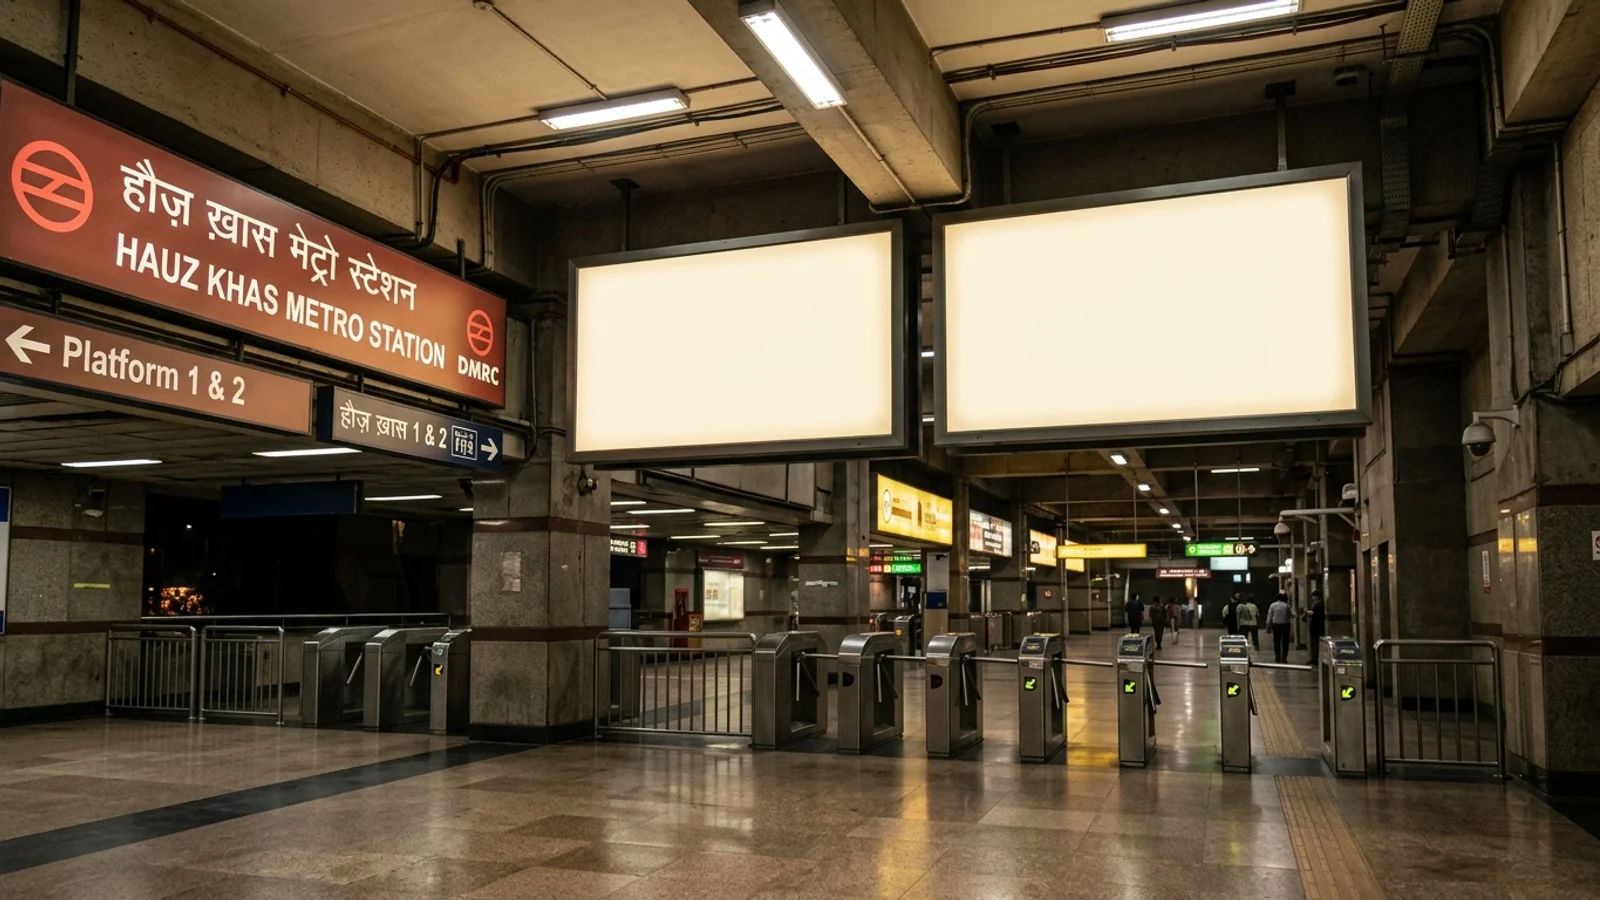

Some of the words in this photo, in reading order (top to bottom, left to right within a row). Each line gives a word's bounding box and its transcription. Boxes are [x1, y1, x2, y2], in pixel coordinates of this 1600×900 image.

[120, 159, 194, 227] हौज़
[206, 199, 278, 258] ख़ास
[289, 223, 339, 287] मेट्रो
[348, 253, 417, 311] स्टेशन
[116, 232, 200, 291] HAUZ
[207, 264, 278, 315] KHAS
[286, 291, 364, 342] METRO
[369, 320, 445, 369] STATION
[62, 335, 179, 391] Platform
[188, 365, 198, 395] 1
[208, 370, 225, 401] &
[232, 376, 245, 405] 2
[458, 355, 499, 386] DMRC
[340, 400, 372, 433] हौज़
[375, 414, 408, 440] ख़ास
[413, 421, 419, 442] 1
[425, 424, 435, 446] &
[439, 427, 447, 449] 2
